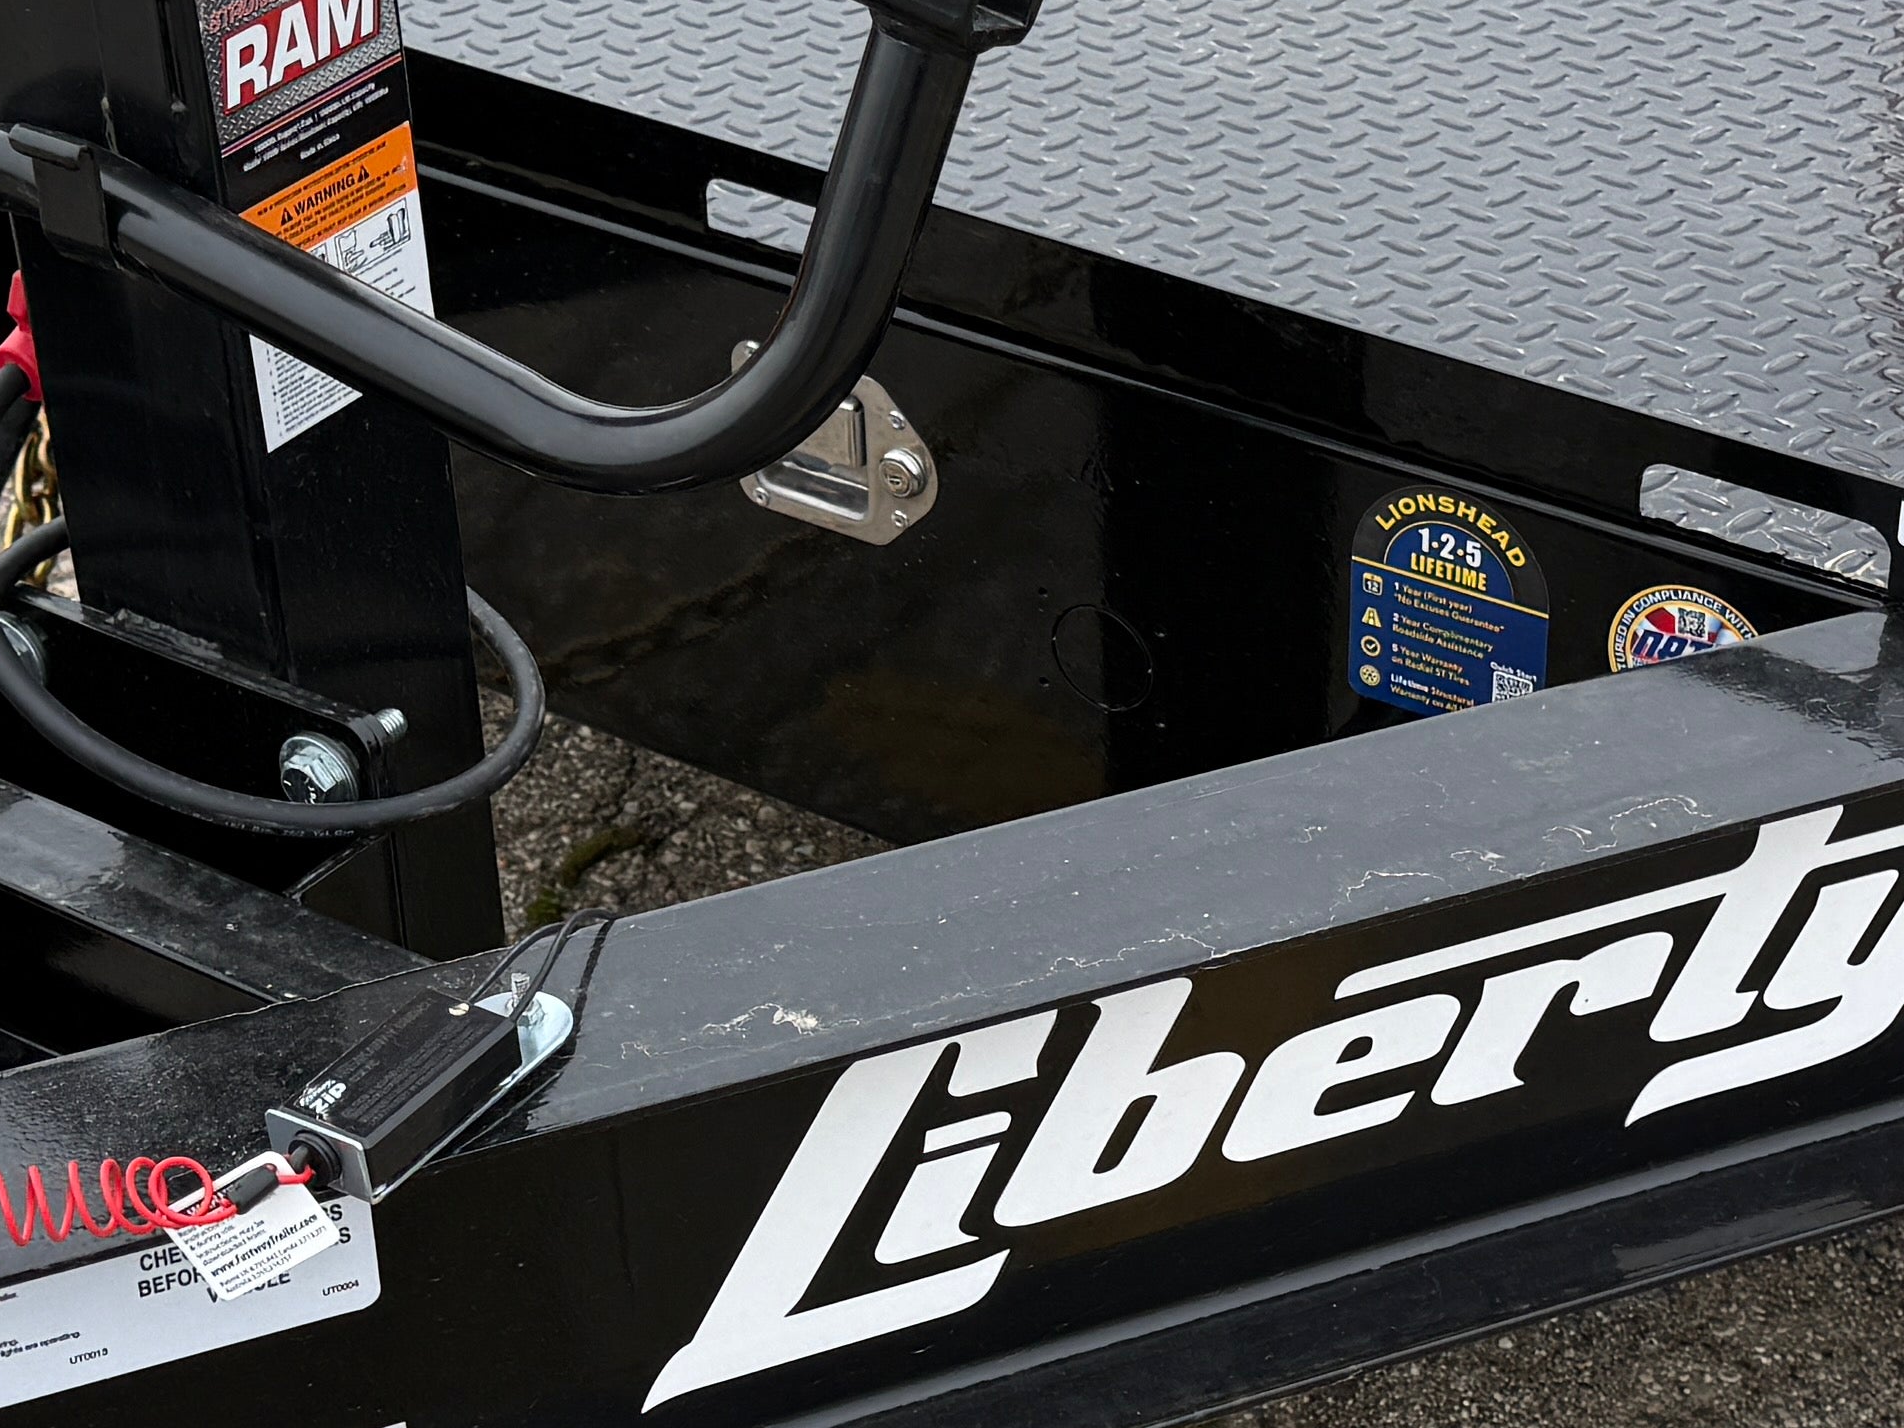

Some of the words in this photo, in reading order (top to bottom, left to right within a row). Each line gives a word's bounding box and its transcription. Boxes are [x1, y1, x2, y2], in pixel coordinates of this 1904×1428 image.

[294, 173, 355, 217] WARNING
[1375, 493, 1526, 568] LIONSHEAD
[1410, 552, 1487, 591] LIFETIME
[1622, 610, 1635, 625] IN
[1632, 589, 1723, 613] COMPLIANCE
[1422, 622, 1493, 652] Complimentary
[1421, 652, 1463, 674] Warranty
[1390, 672, 1428, 693] Lifetime
[139, 1246, 189, 1272] CHE
[138, 1267, 206, 1298] BEFOR
